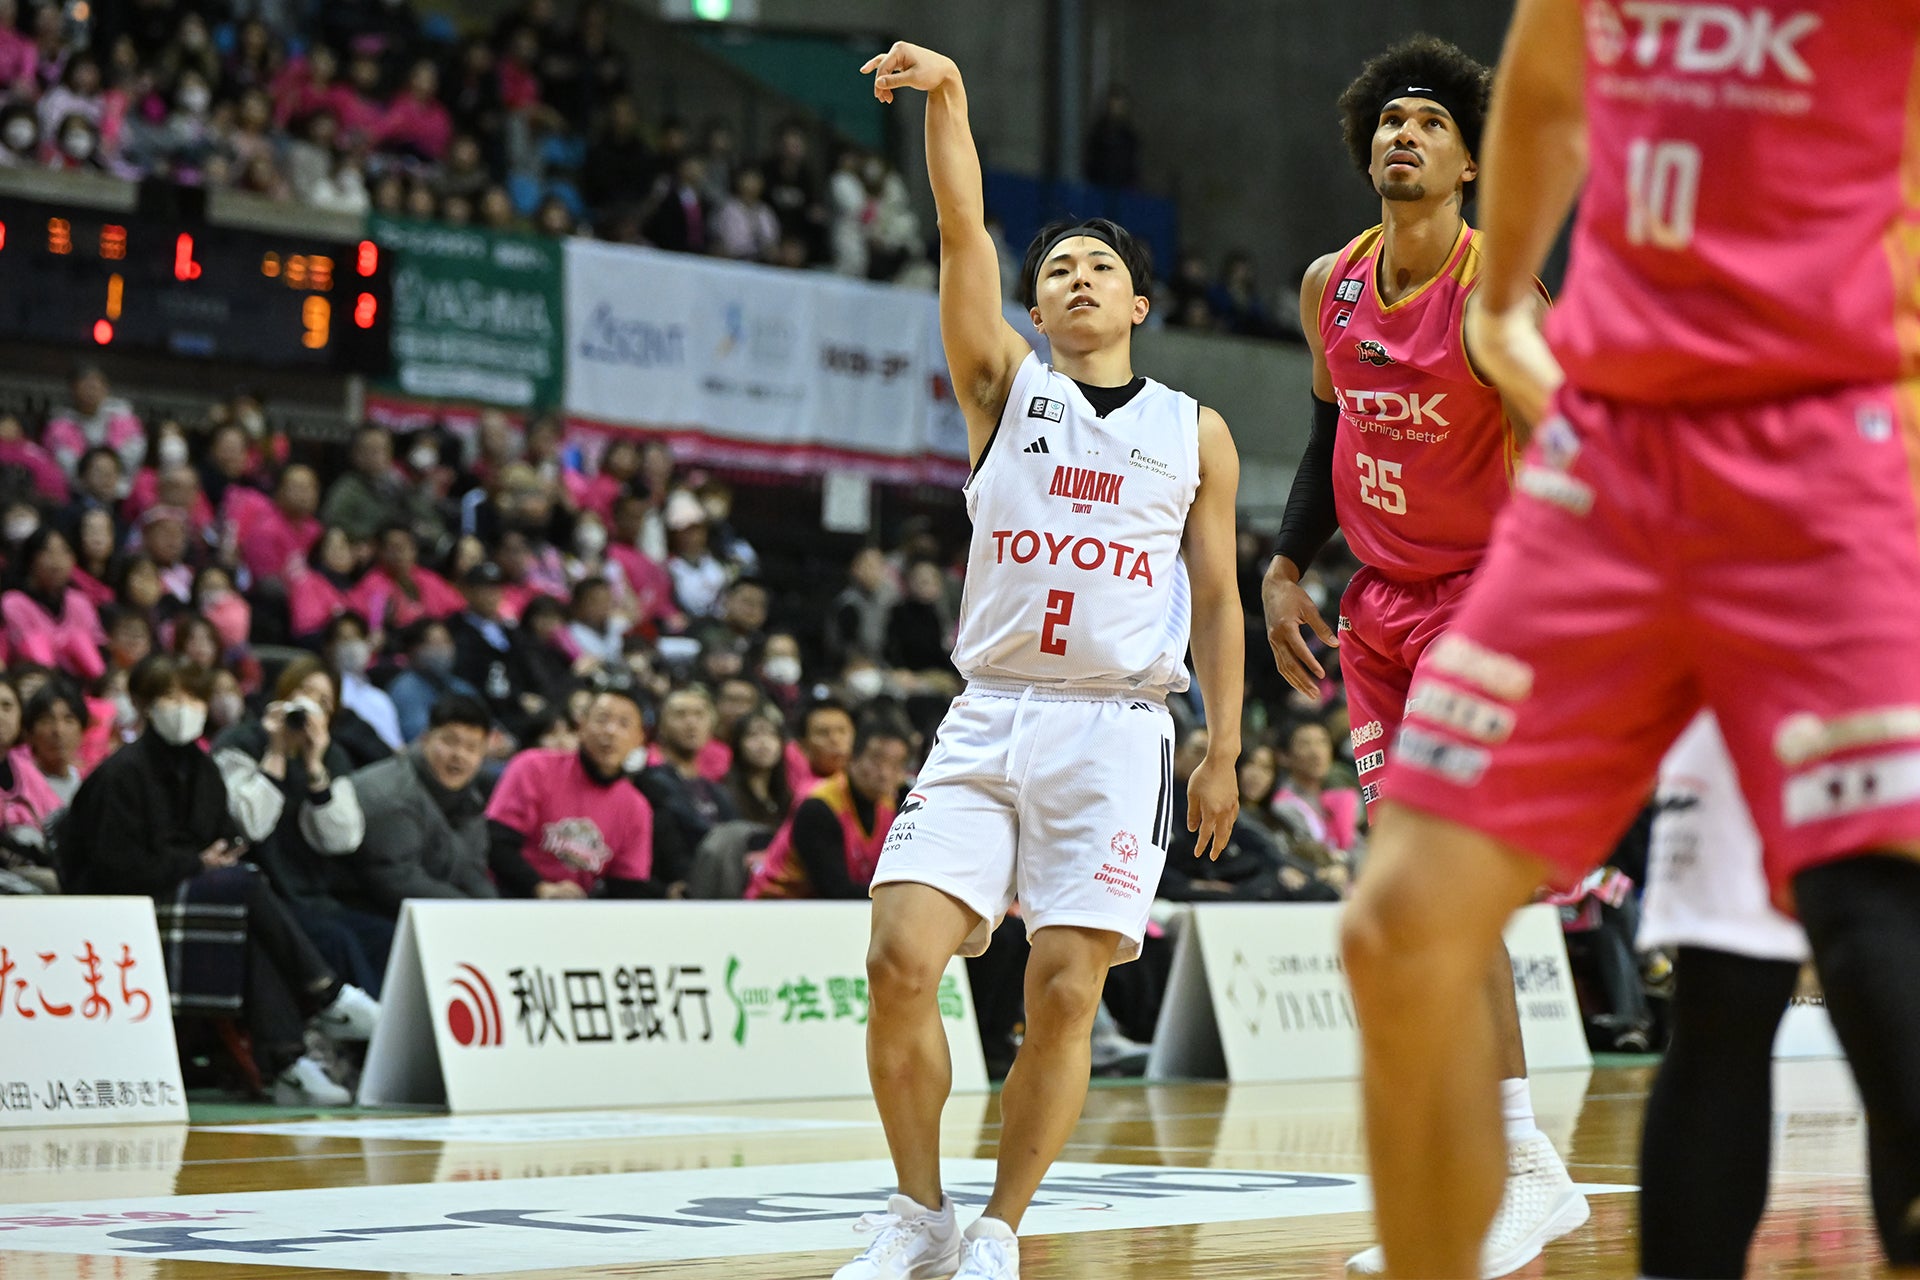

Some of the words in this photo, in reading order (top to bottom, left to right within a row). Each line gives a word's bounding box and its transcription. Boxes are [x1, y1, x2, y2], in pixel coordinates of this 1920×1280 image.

[1621, 3, 1822, 83] TDK
[1626, 139, 1699, 247] 10
[1345, 389, 1450, 426] TDK
[1406, 429, 1450, 443] Better
[1048, 465, 1124, 505] ALVARK
[1071, 502, 1092, 514] TOKYO
[1356, 452, 1407, 515] 25
[992, 529, 1153, 587] TOYOTA
[1039, 589, 1075, 656] 2
[1094, 872, 1141, 894] Olympics
[1101, 863, 1139, 881] Special
[1106, 886, 1132, 899] Nippon
[0, 938, 152, 1024] たこまち
[508, 966, 711, 1045] 秋田銀行
[777, 974, 964, 1024] 佐野局
